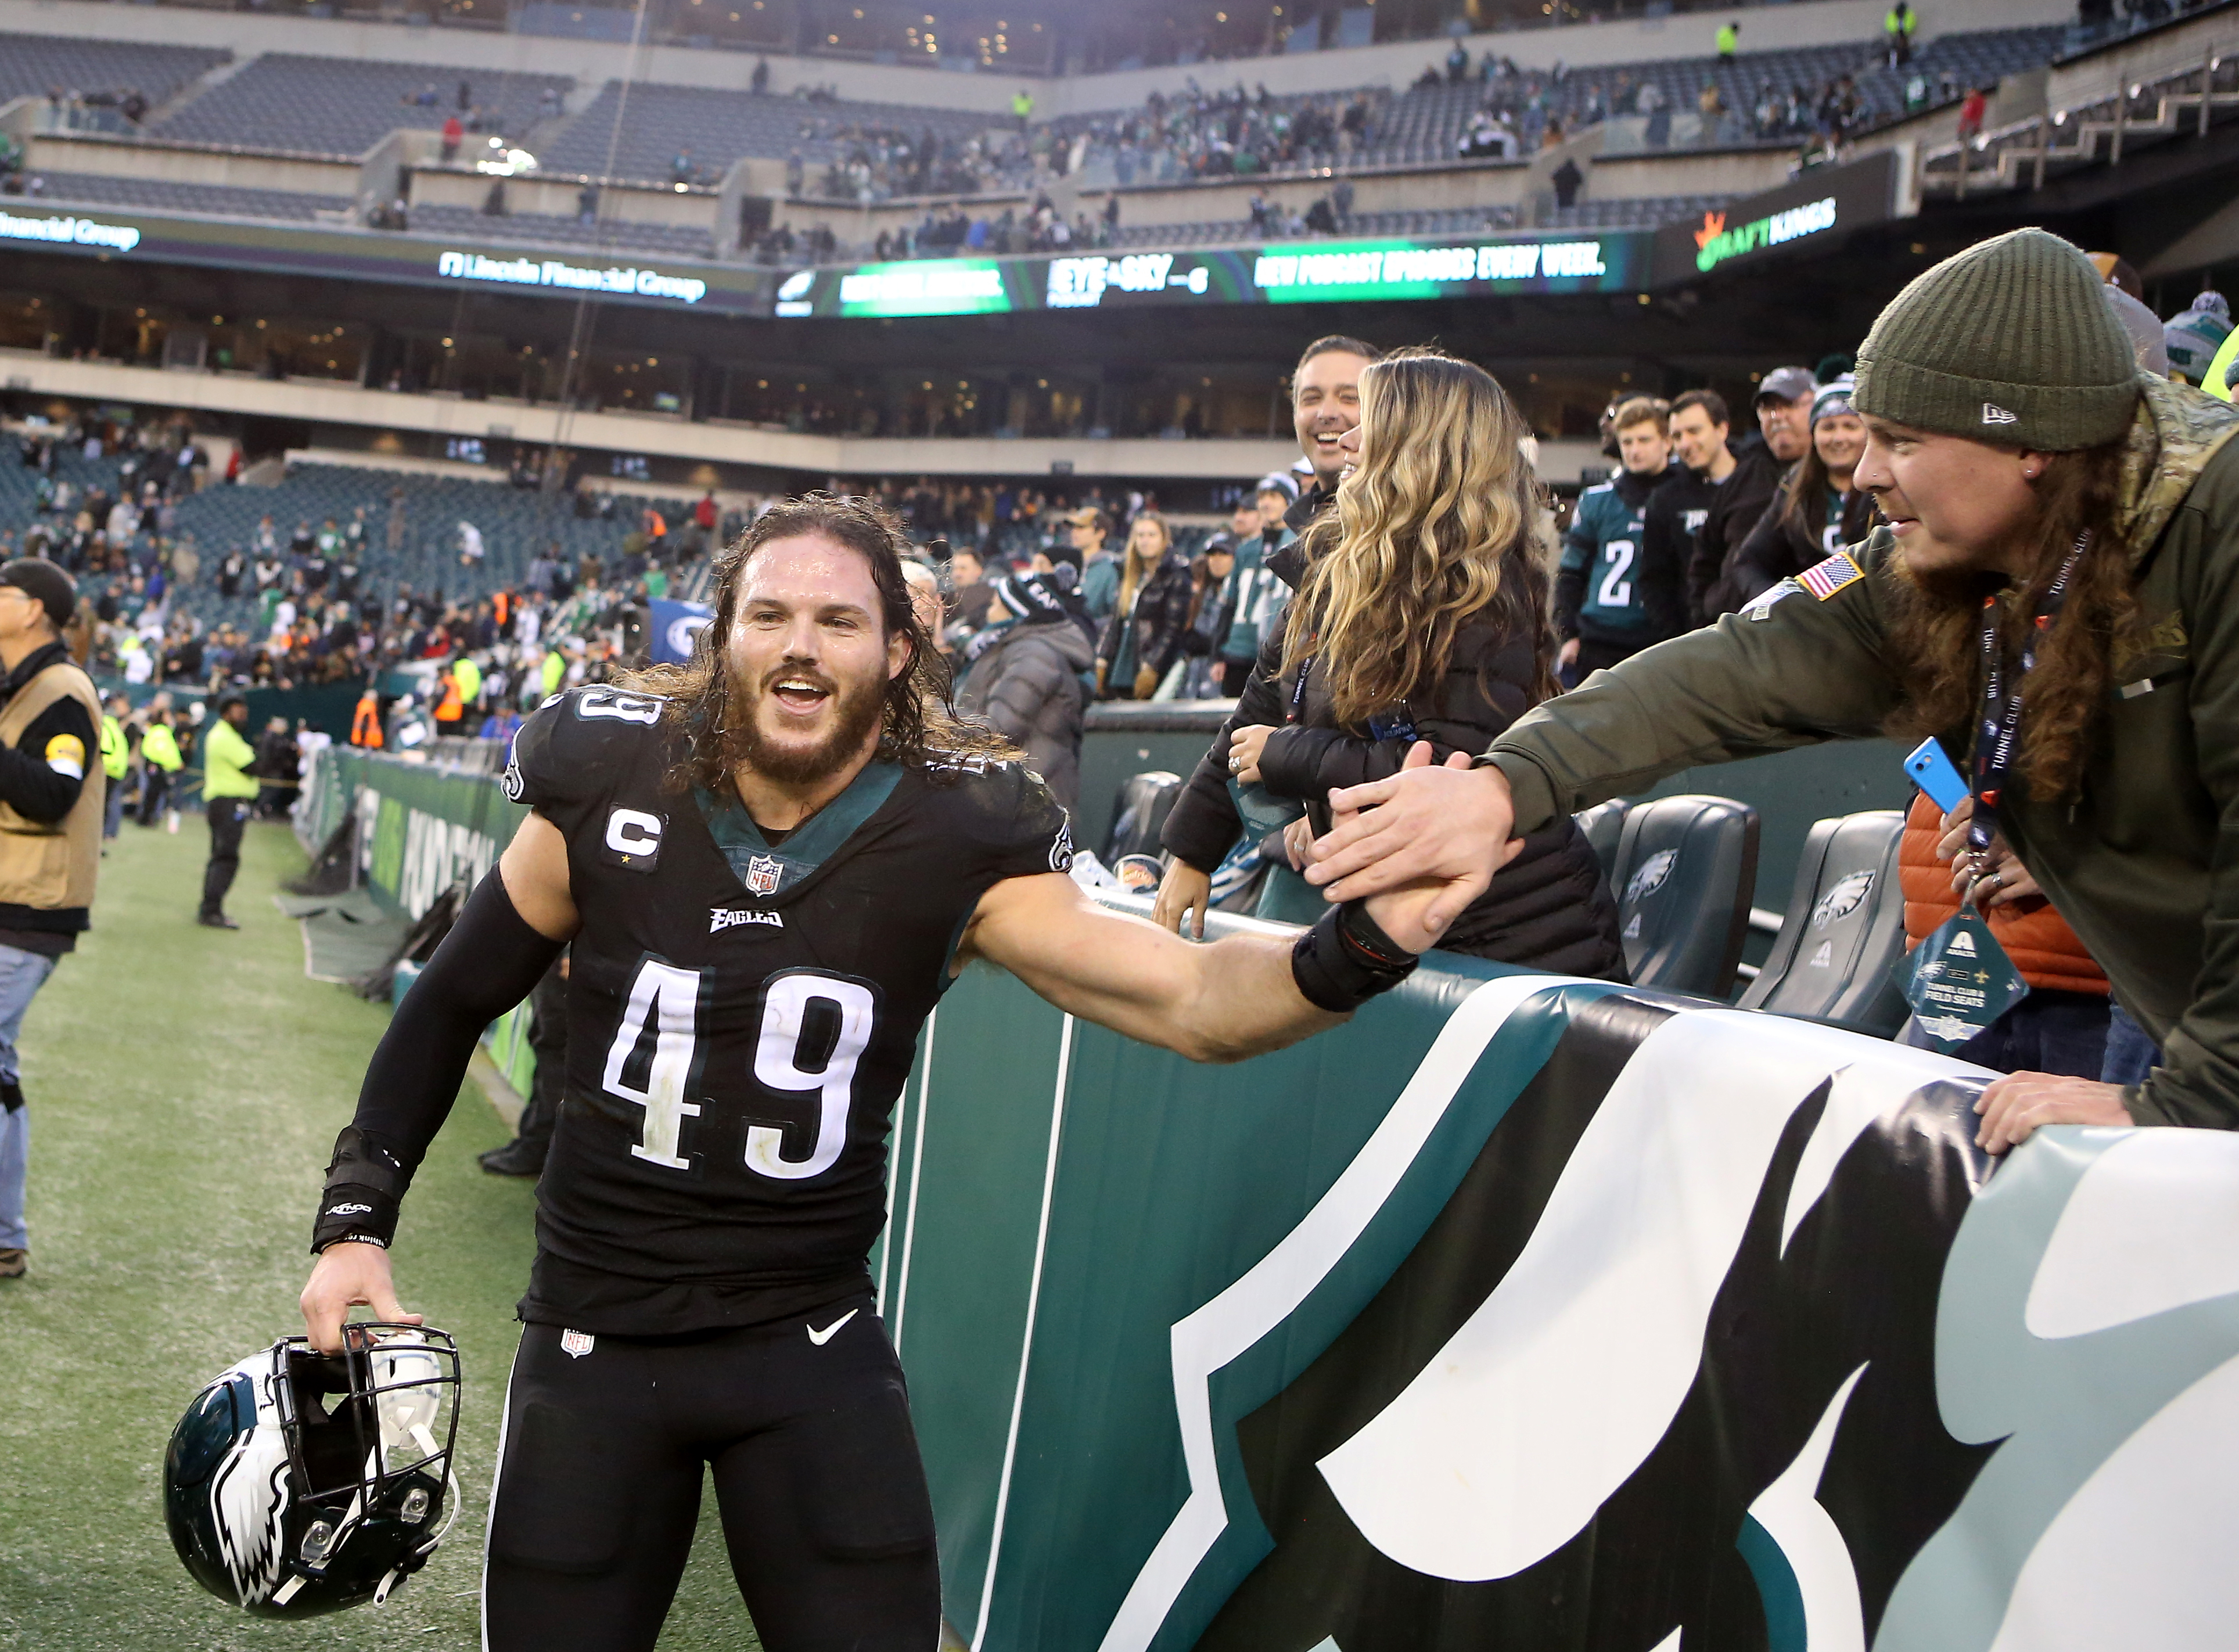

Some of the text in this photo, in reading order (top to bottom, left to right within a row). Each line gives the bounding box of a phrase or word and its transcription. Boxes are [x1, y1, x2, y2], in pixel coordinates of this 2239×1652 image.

[1048, 257, 1109, 292] EYE
[1992, 696, 2022, 769] TUNNEL CLUB
[605, 808, 662, 857] C
[751, 871, 772, 890] NFL
[709, 908, 784, 934] EAGLES
[1925, 991, 1985, 1008] FIELD SEATS
[1926, 982, 1957, 992] TUNNEL
[1957, 986, 1978, 996] CLUB
[602, 959, 874, 1179] 49
[567, 1333, 588, 1351] NFL
